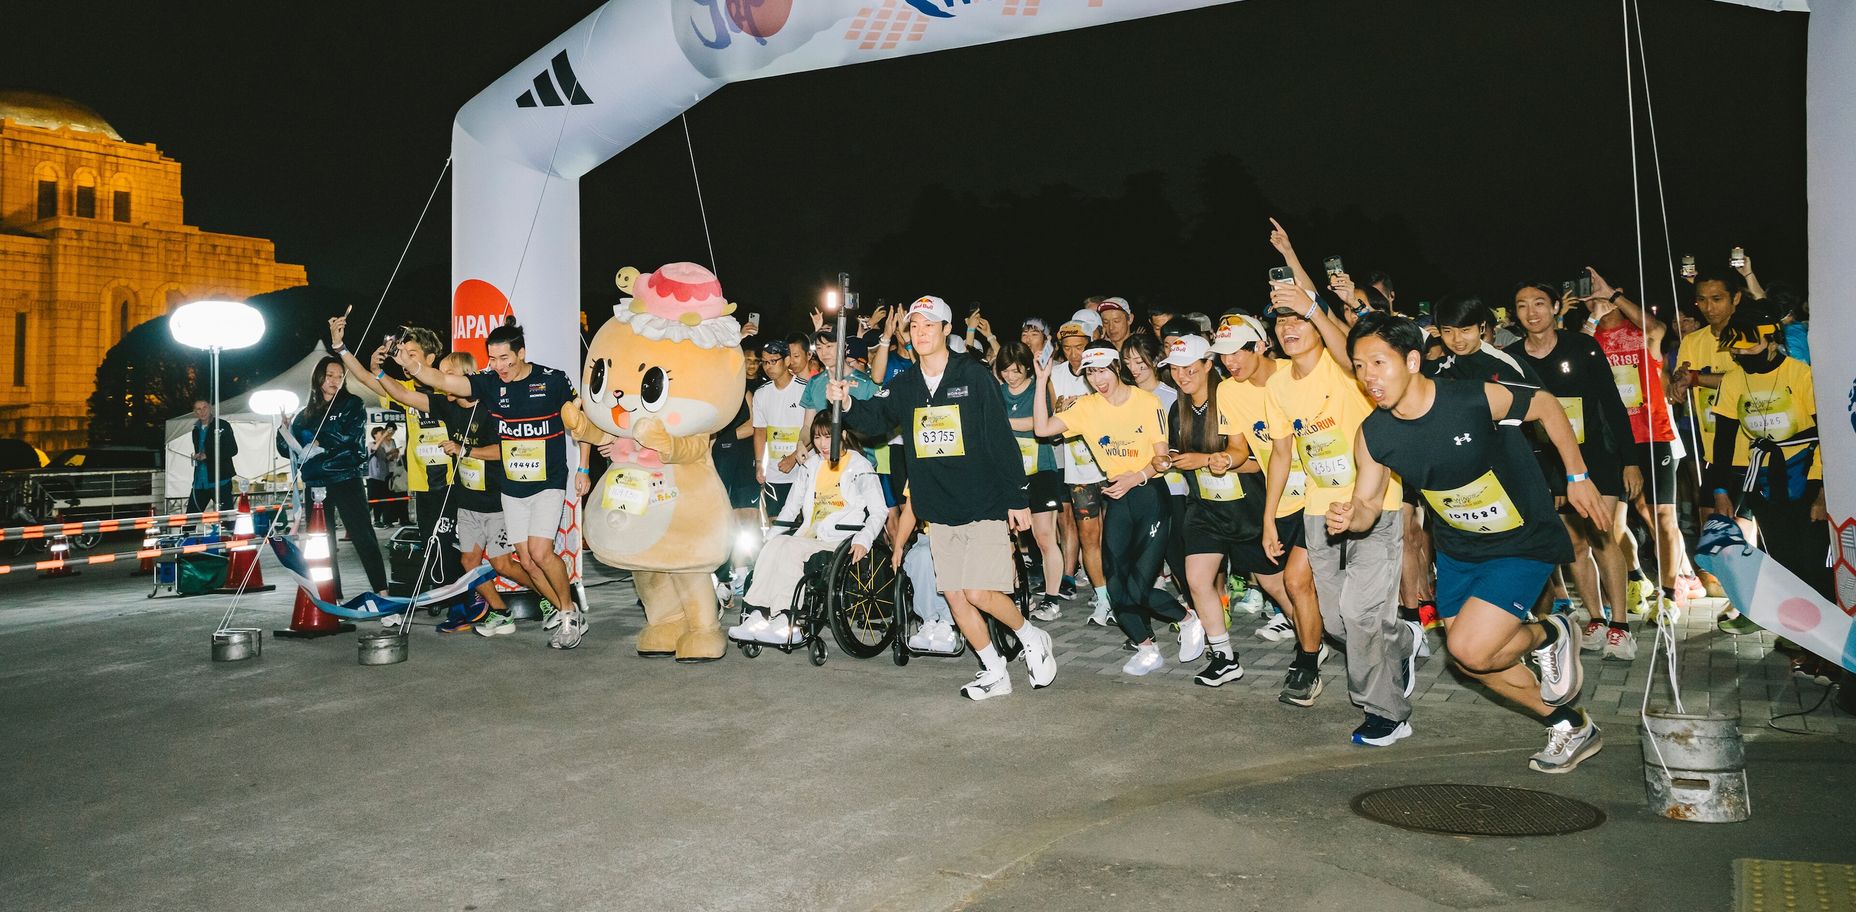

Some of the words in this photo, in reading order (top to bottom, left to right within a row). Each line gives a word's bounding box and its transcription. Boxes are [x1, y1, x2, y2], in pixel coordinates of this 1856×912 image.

[498, 420, 522, 437] Red
[523, 420, 550, 437] Bull
[922, 430, 955, 443] 83755
[509, 461, 539, 469] 194465
[1449, 506, 1497, 521] 107689
